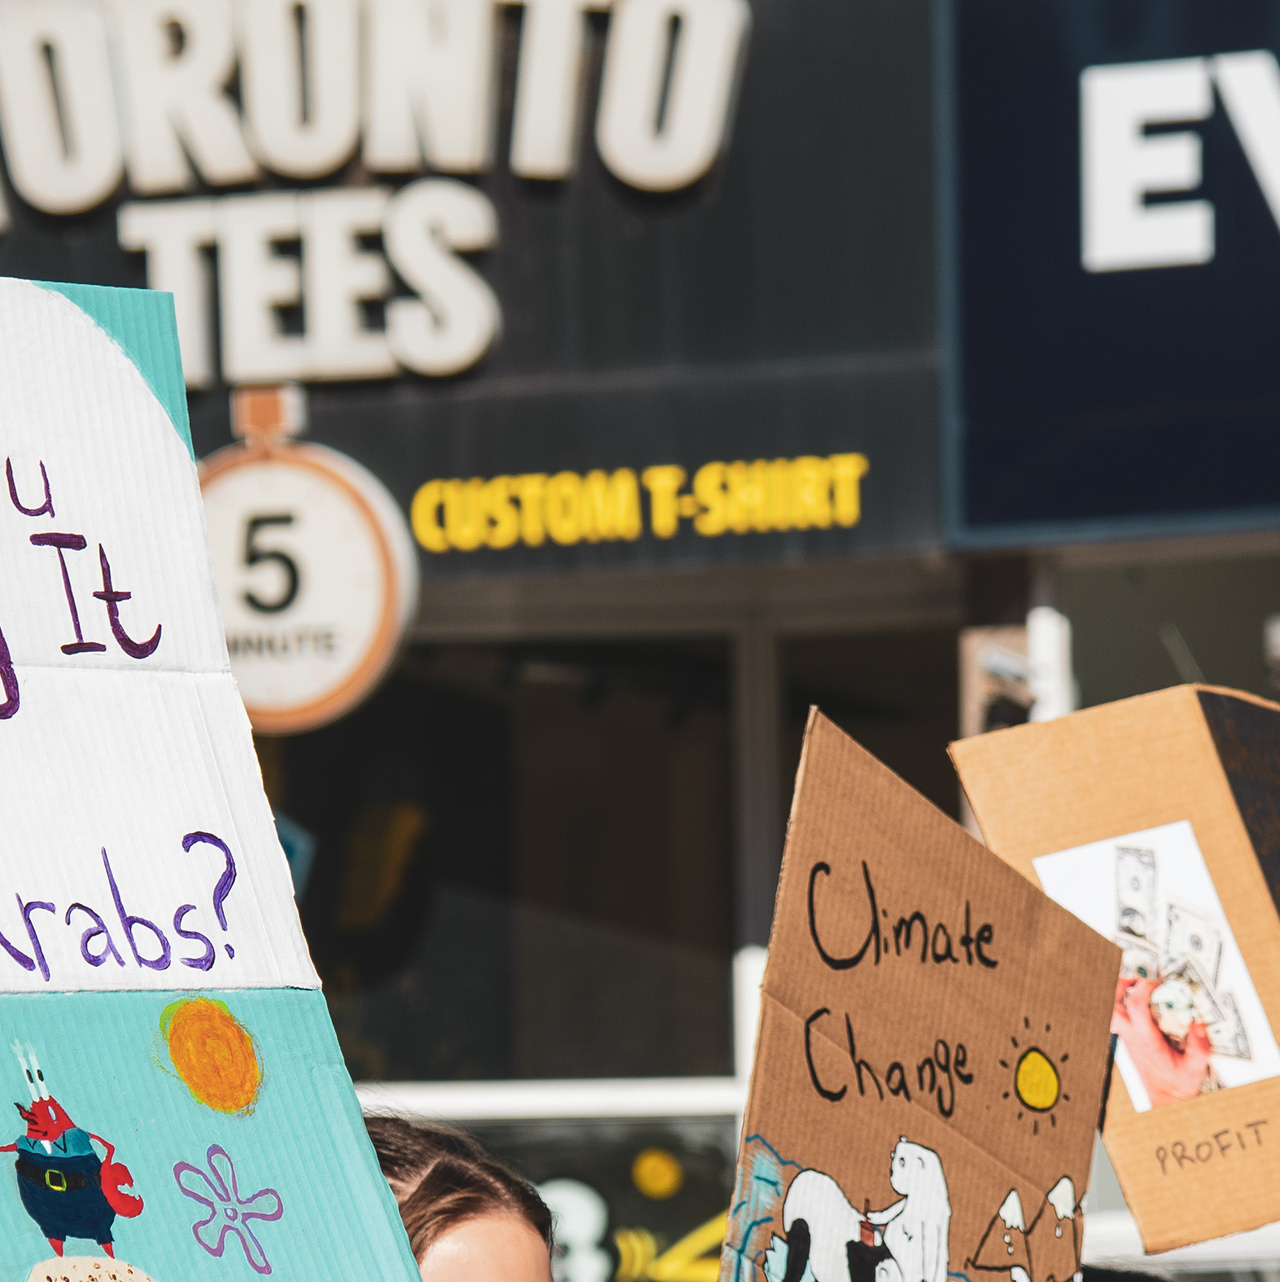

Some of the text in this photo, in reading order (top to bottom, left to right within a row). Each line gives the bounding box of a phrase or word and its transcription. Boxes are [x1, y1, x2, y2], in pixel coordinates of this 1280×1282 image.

[120, 178, 502, 390] TEES
[411, 452, 868, 553] CUSTOM T-SHIRT
[30, 532, 162, 660] It
[241, 511, 301, 615] 5
[224, 626, 336, 660] INUTE
[806, 859, 1000, 971] Climate
[804, 1006, 975, 1120] Change
[1154, 1118, 1269, 1177] PROFIT
